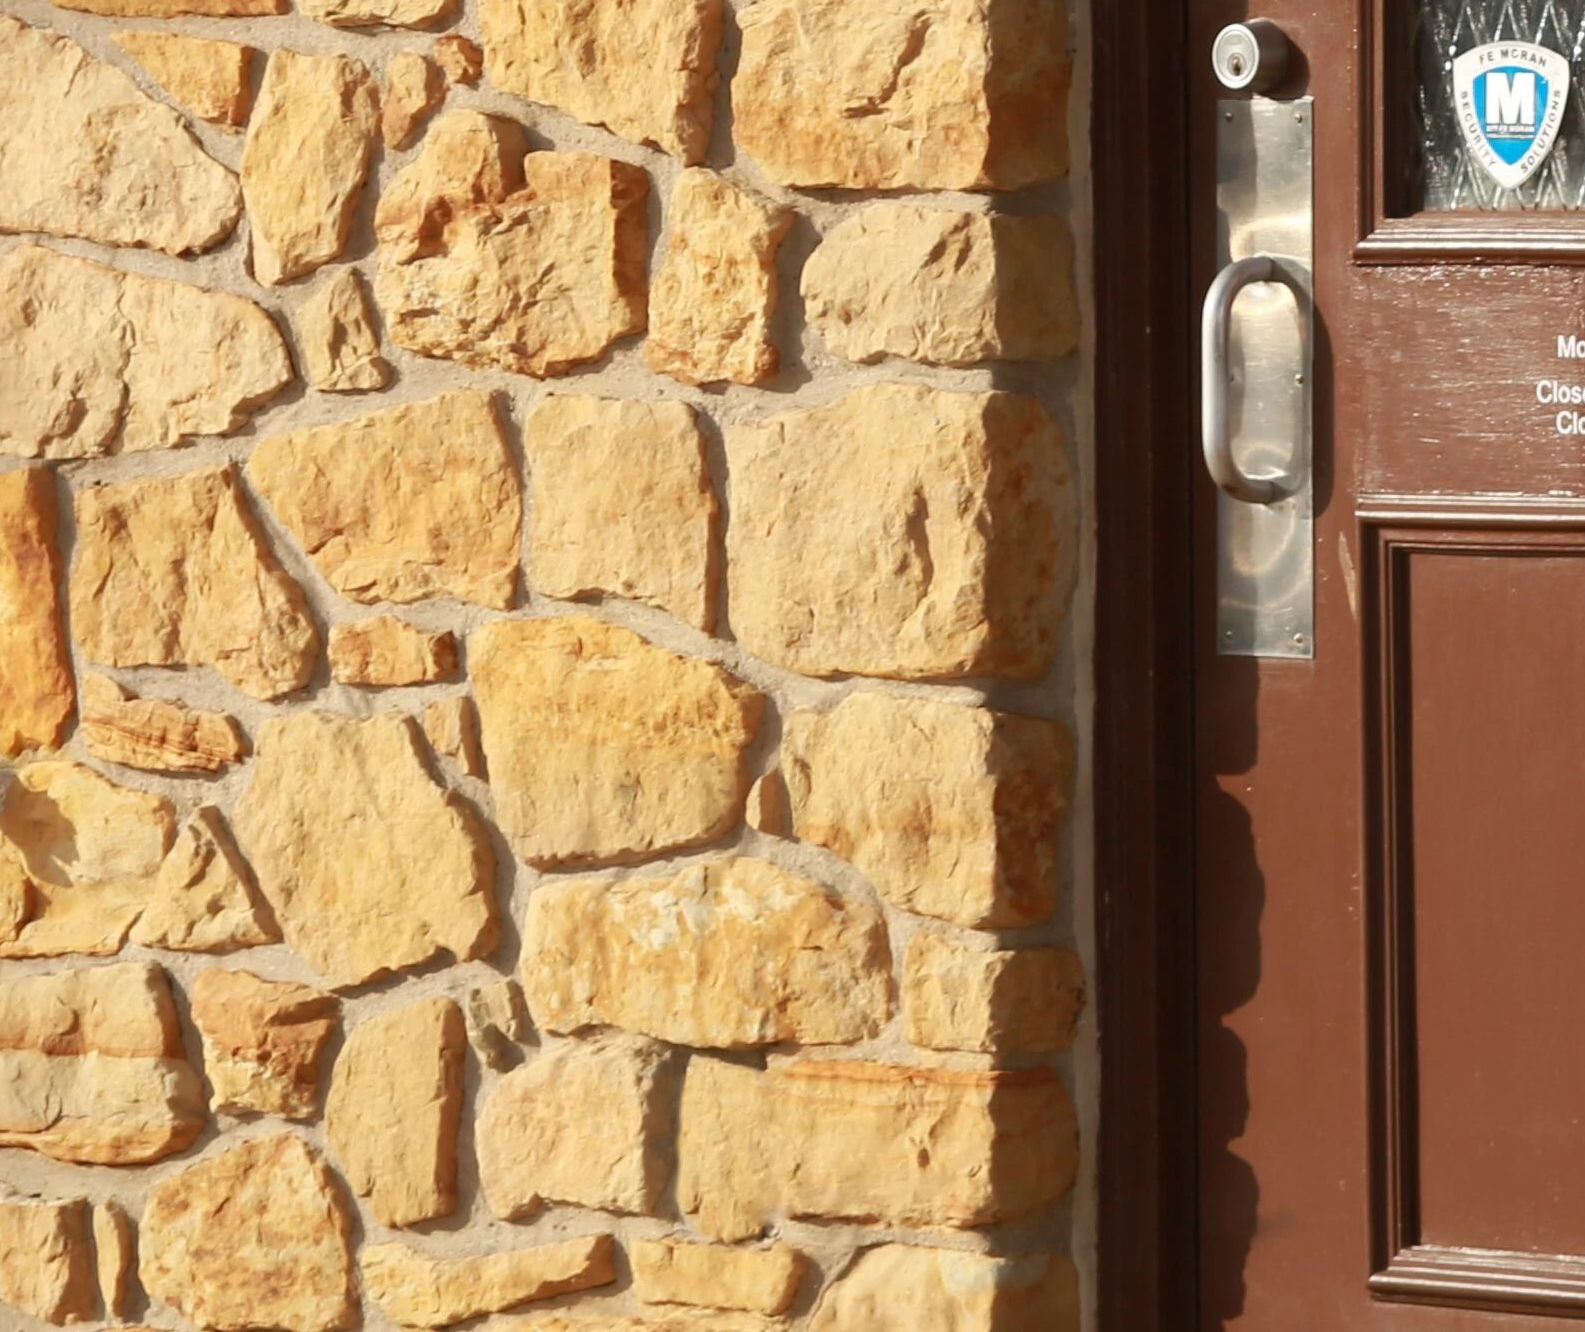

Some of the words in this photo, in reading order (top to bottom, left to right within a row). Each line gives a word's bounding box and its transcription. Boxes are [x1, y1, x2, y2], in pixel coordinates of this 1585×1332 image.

[1479, 51, 1494, 65] FE
[1461, 90, 1496, 168] SECURITY
[1486, 72, 1535, 125] M
[1520, 89, 1561, 173] SOLUTIONS
